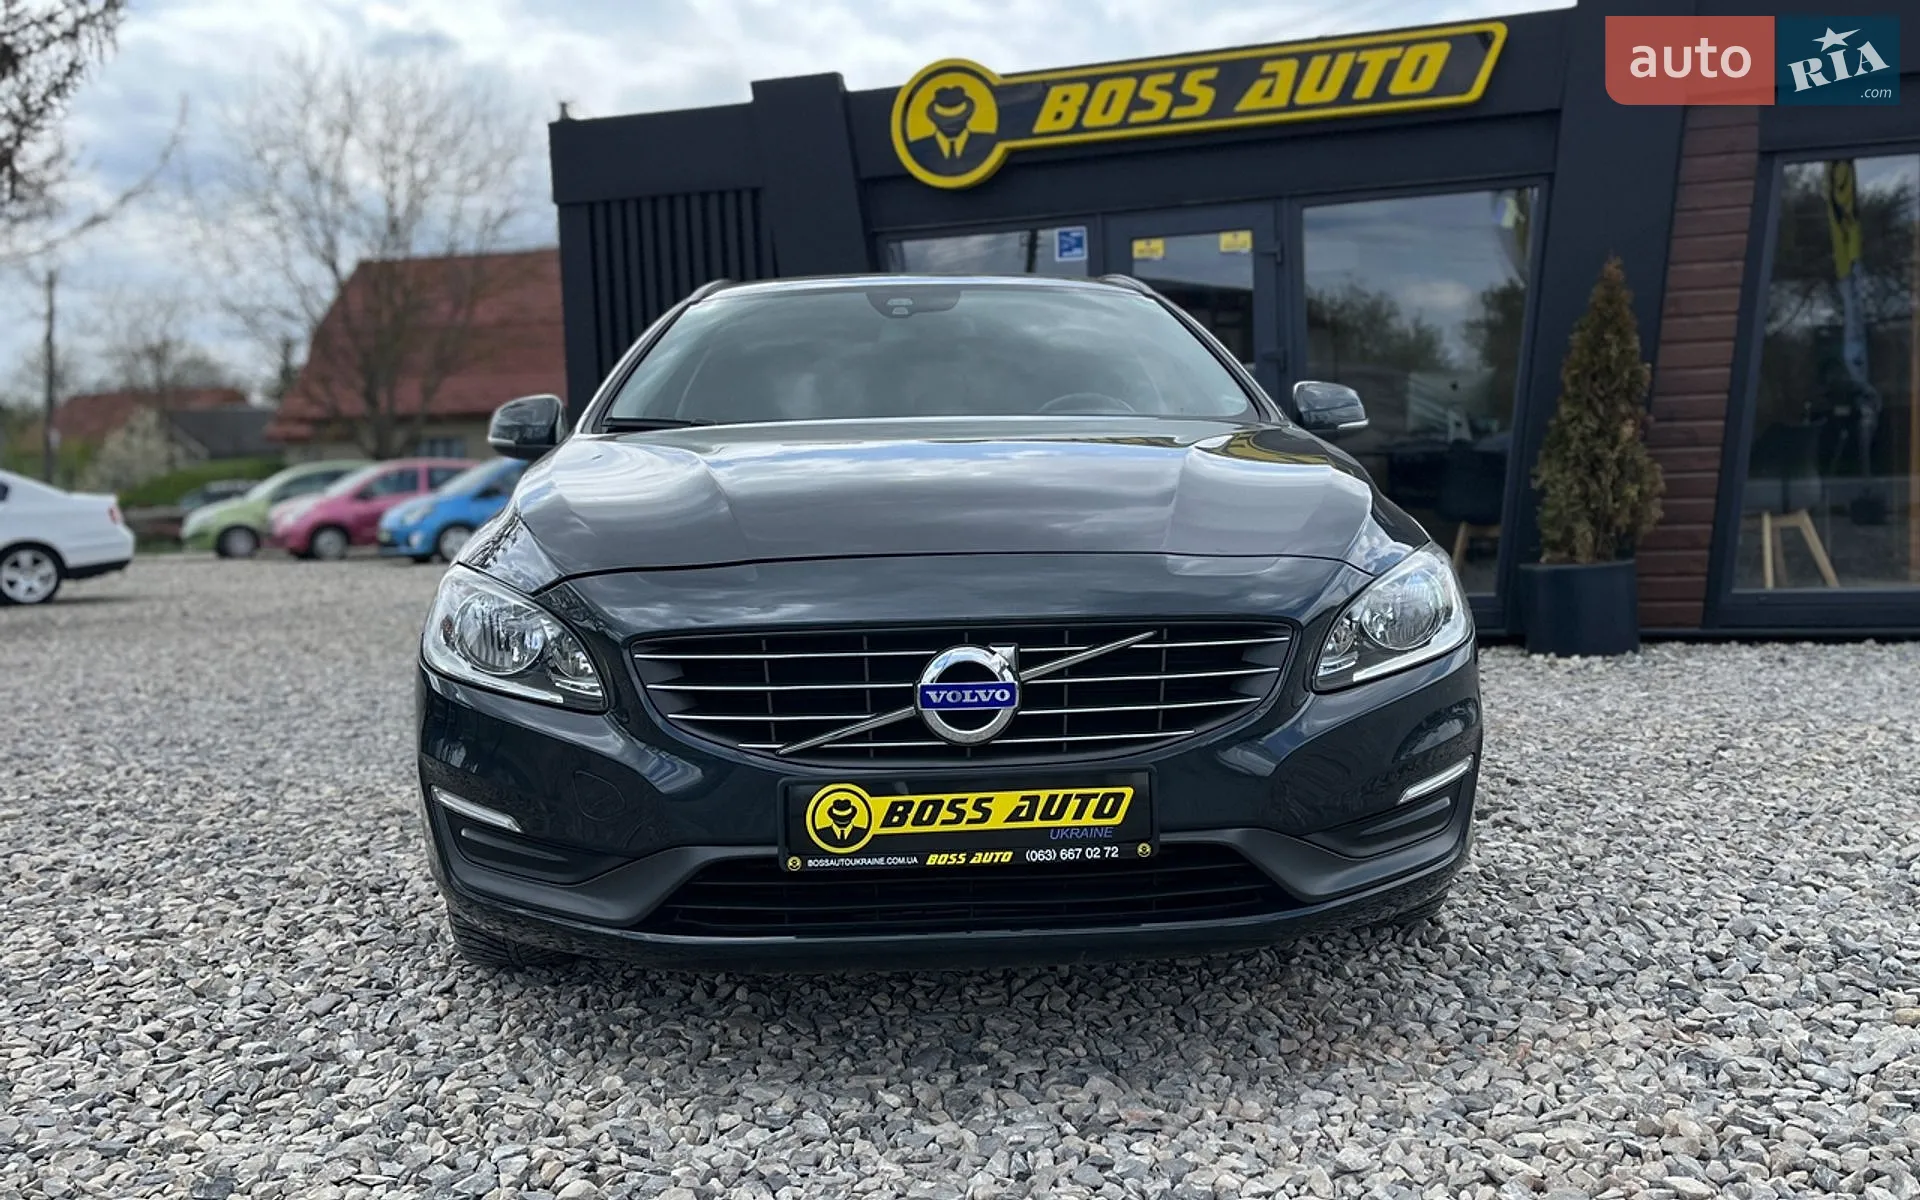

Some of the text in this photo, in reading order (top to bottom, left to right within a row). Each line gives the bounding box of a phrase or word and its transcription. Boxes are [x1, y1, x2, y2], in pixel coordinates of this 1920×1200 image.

[1032, 41, 1452, 134] BOSS AUTO
[925, 688, 1011, 703] VOLVO
[879, 792, 1126, 828] BOSS AUTO
[1050, 826, 1114, 840] UKRAINE
[926, 851, 1014, 866] BOSS AUTO
[1025, 845, 1119, 862] (063) 667 02 72
[807, 856, 919, 868] BOSSAUTOUKRAINE.COM.UA
